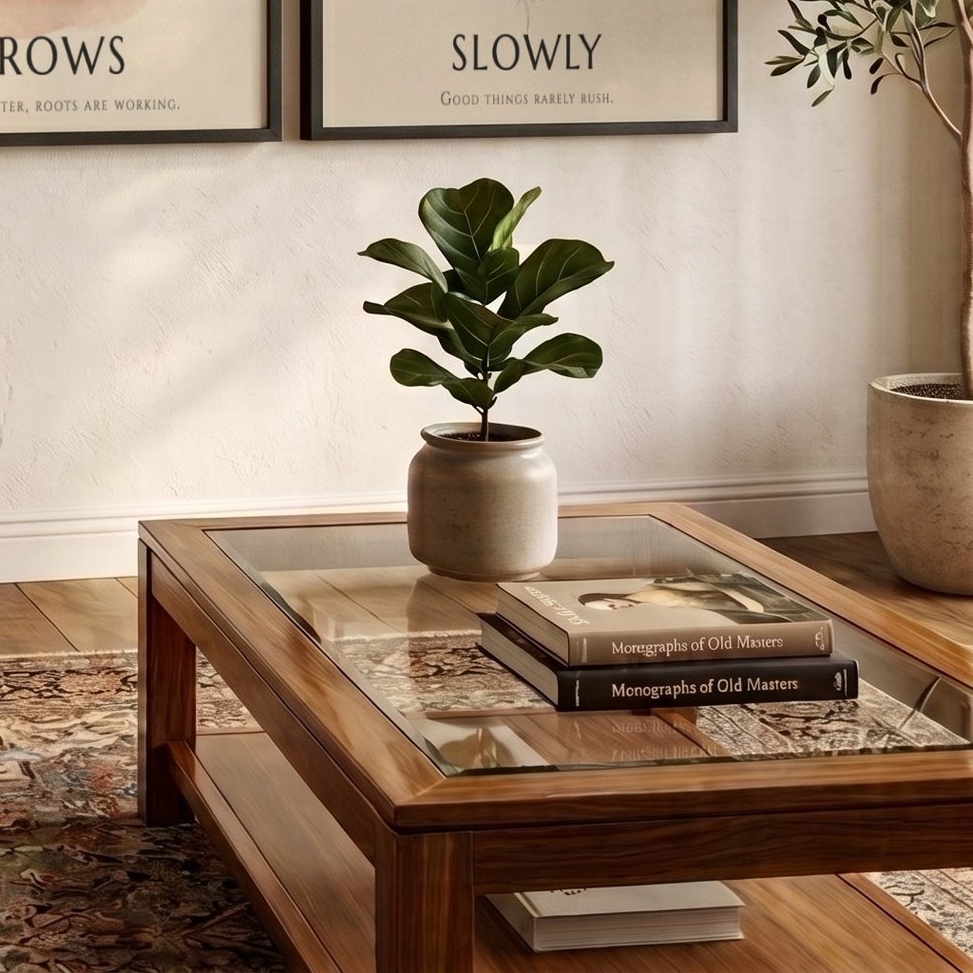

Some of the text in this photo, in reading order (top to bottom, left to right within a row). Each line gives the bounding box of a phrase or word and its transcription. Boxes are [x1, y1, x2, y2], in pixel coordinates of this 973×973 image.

[452, 33, 603, 72] SLOWLY
[35, 99, 78, 113] ROOTS
[83, 99, 108, 112] ARE
[483, 93, 529, 106] THINGS
[533, 93, 576, 105] RARELY
[691, 637, 706, 651] of
[708, 636, 733, 651] Old
[612, 677, 799, 700] Monographs of Old Masters
